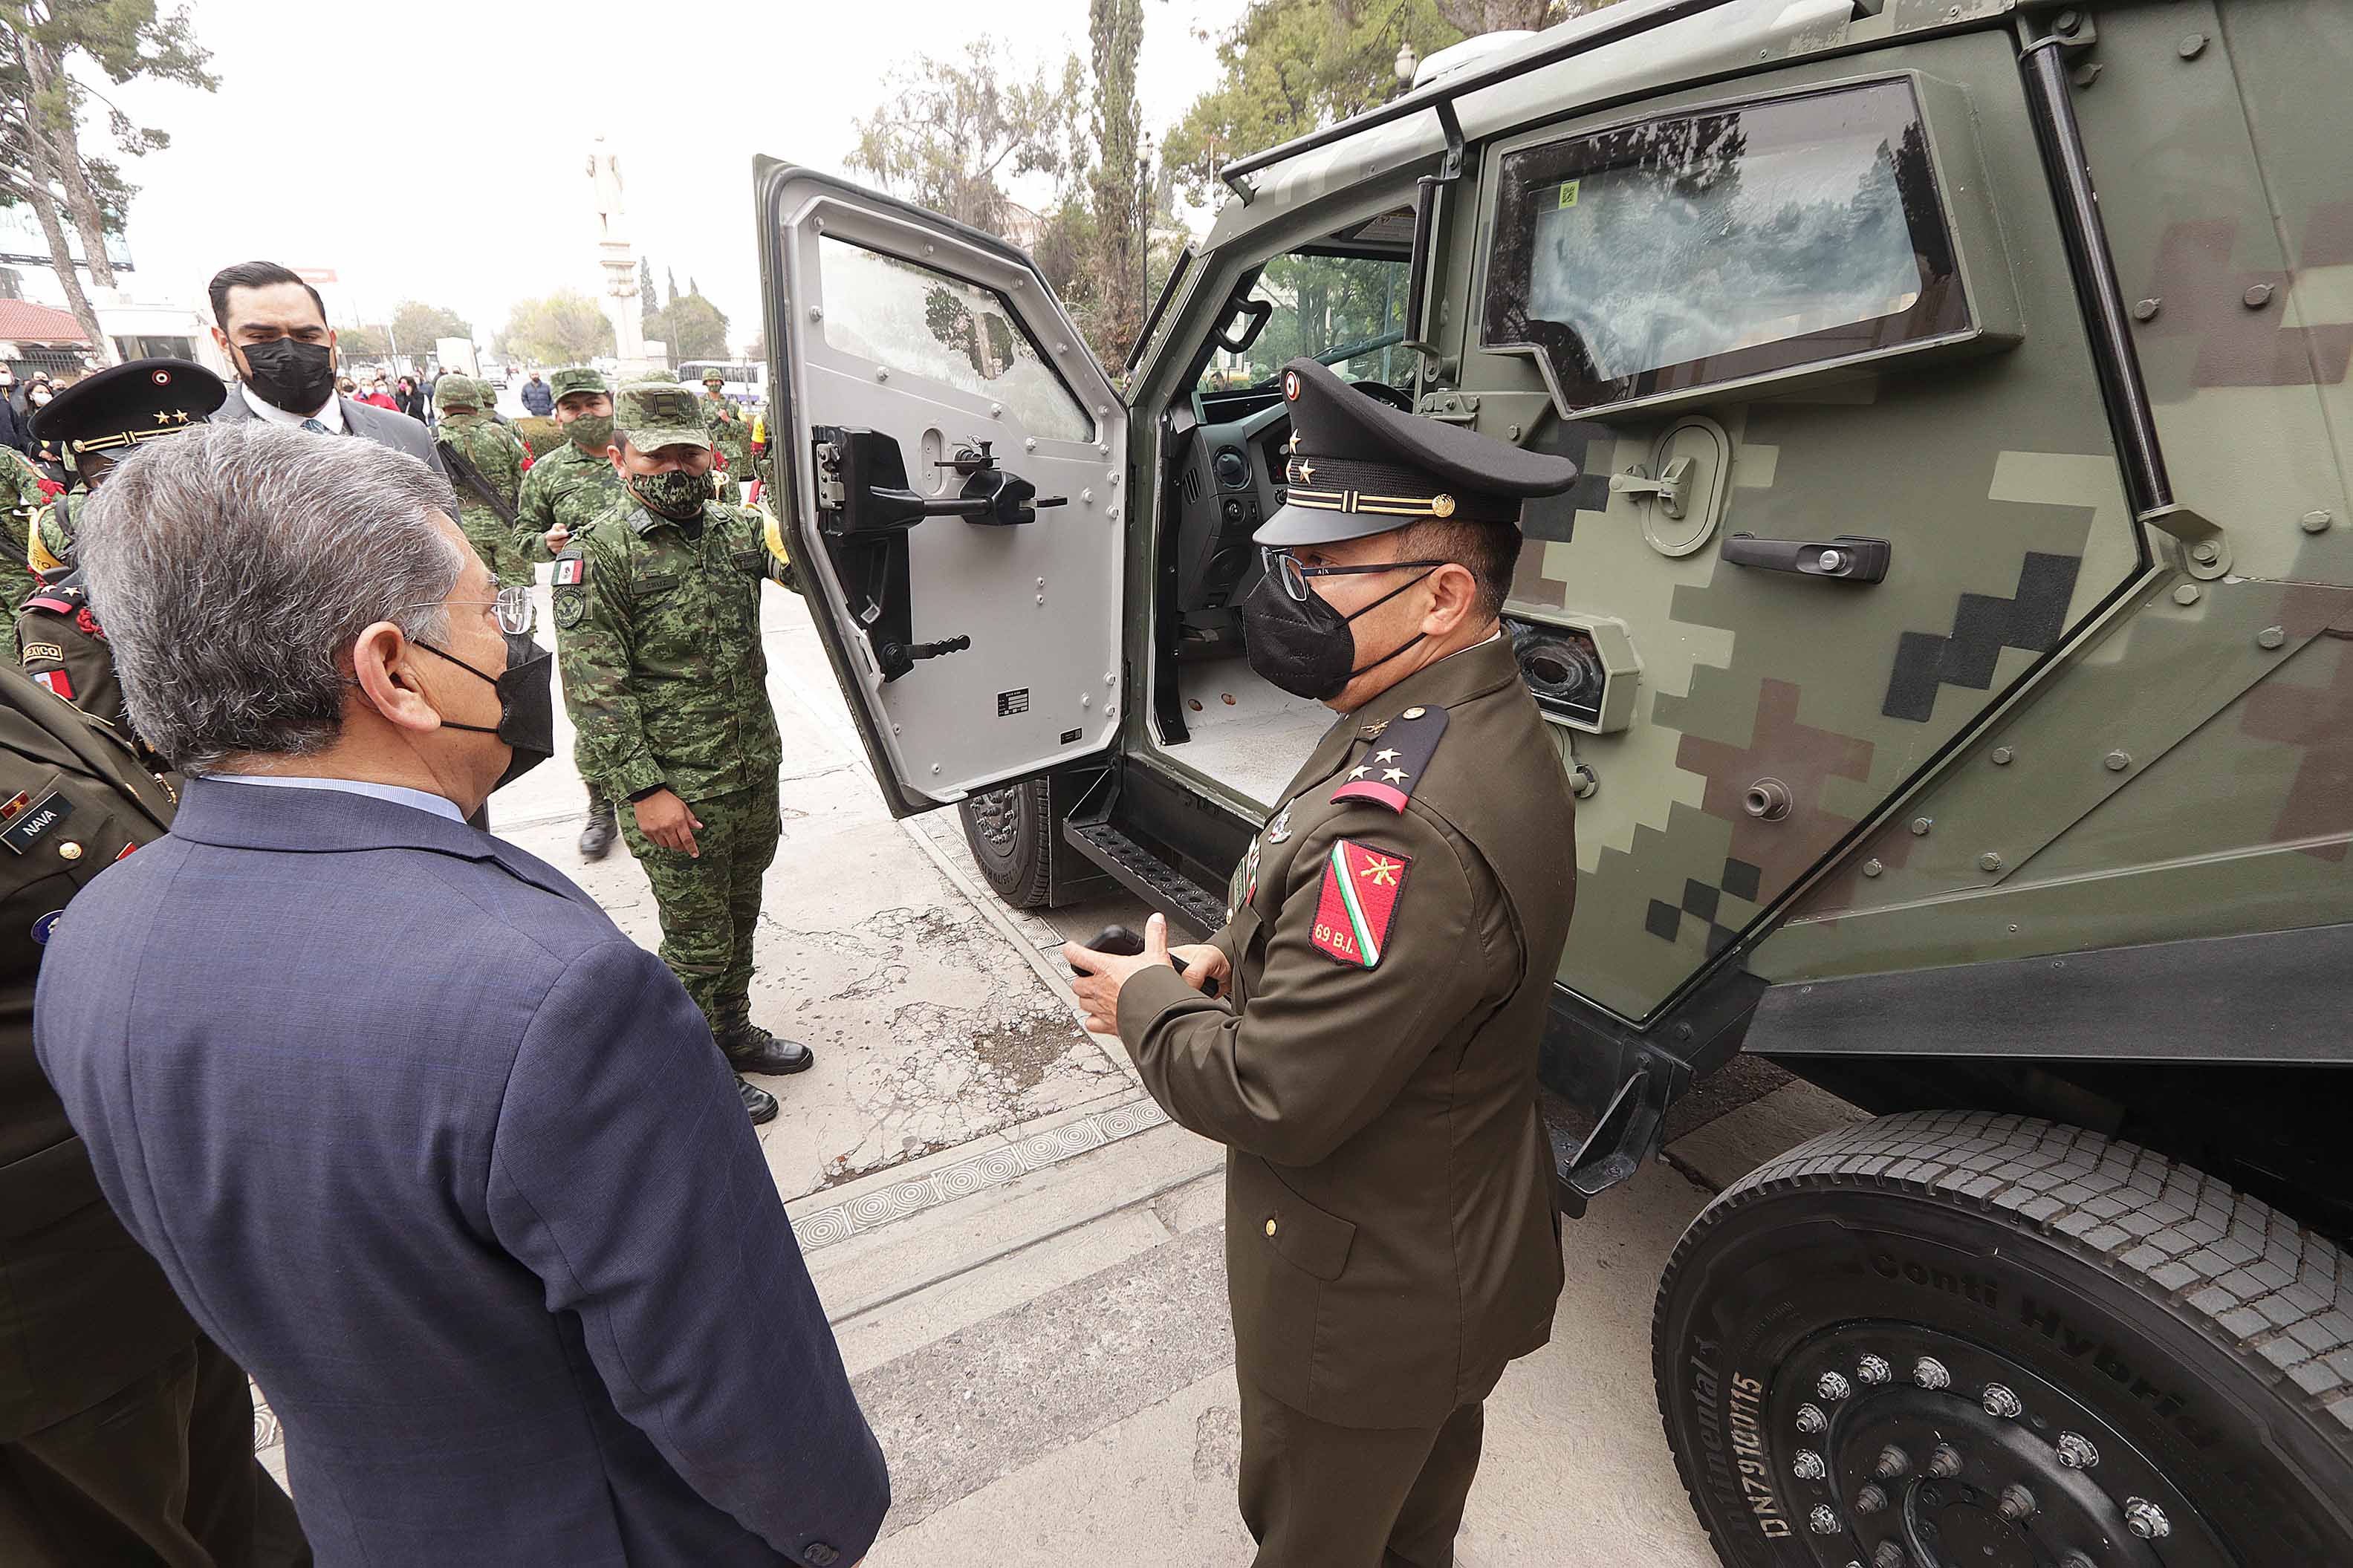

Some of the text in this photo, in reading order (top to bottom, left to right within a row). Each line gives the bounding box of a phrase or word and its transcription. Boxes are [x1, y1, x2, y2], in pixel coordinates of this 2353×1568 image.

[646, 580, 666, 589] CRUZ
[22, 810, 58, 836] NAVA
[1315, 923, 1354, 954] 69 B.I.
